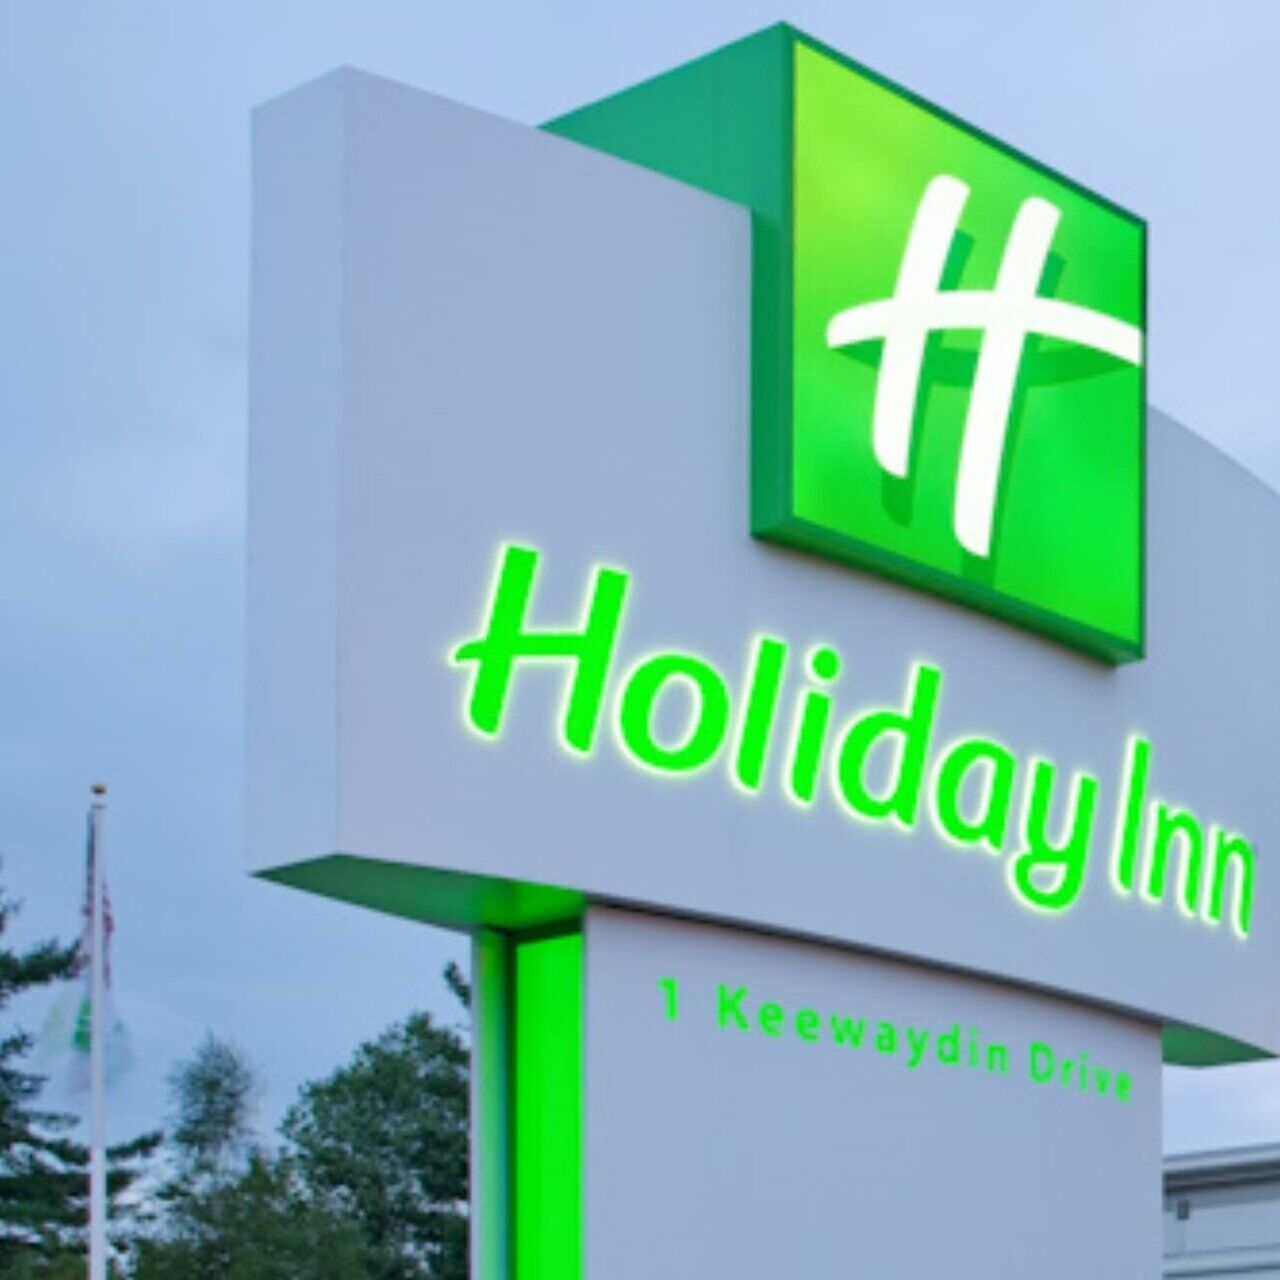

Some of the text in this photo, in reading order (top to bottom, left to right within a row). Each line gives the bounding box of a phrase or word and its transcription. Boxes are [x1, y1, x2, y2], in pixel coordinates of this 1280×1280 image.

[452, 543, 1257, 935] Holiday Inn
[656, 976, 1134, 1105] 1 Keewaydin Drive
